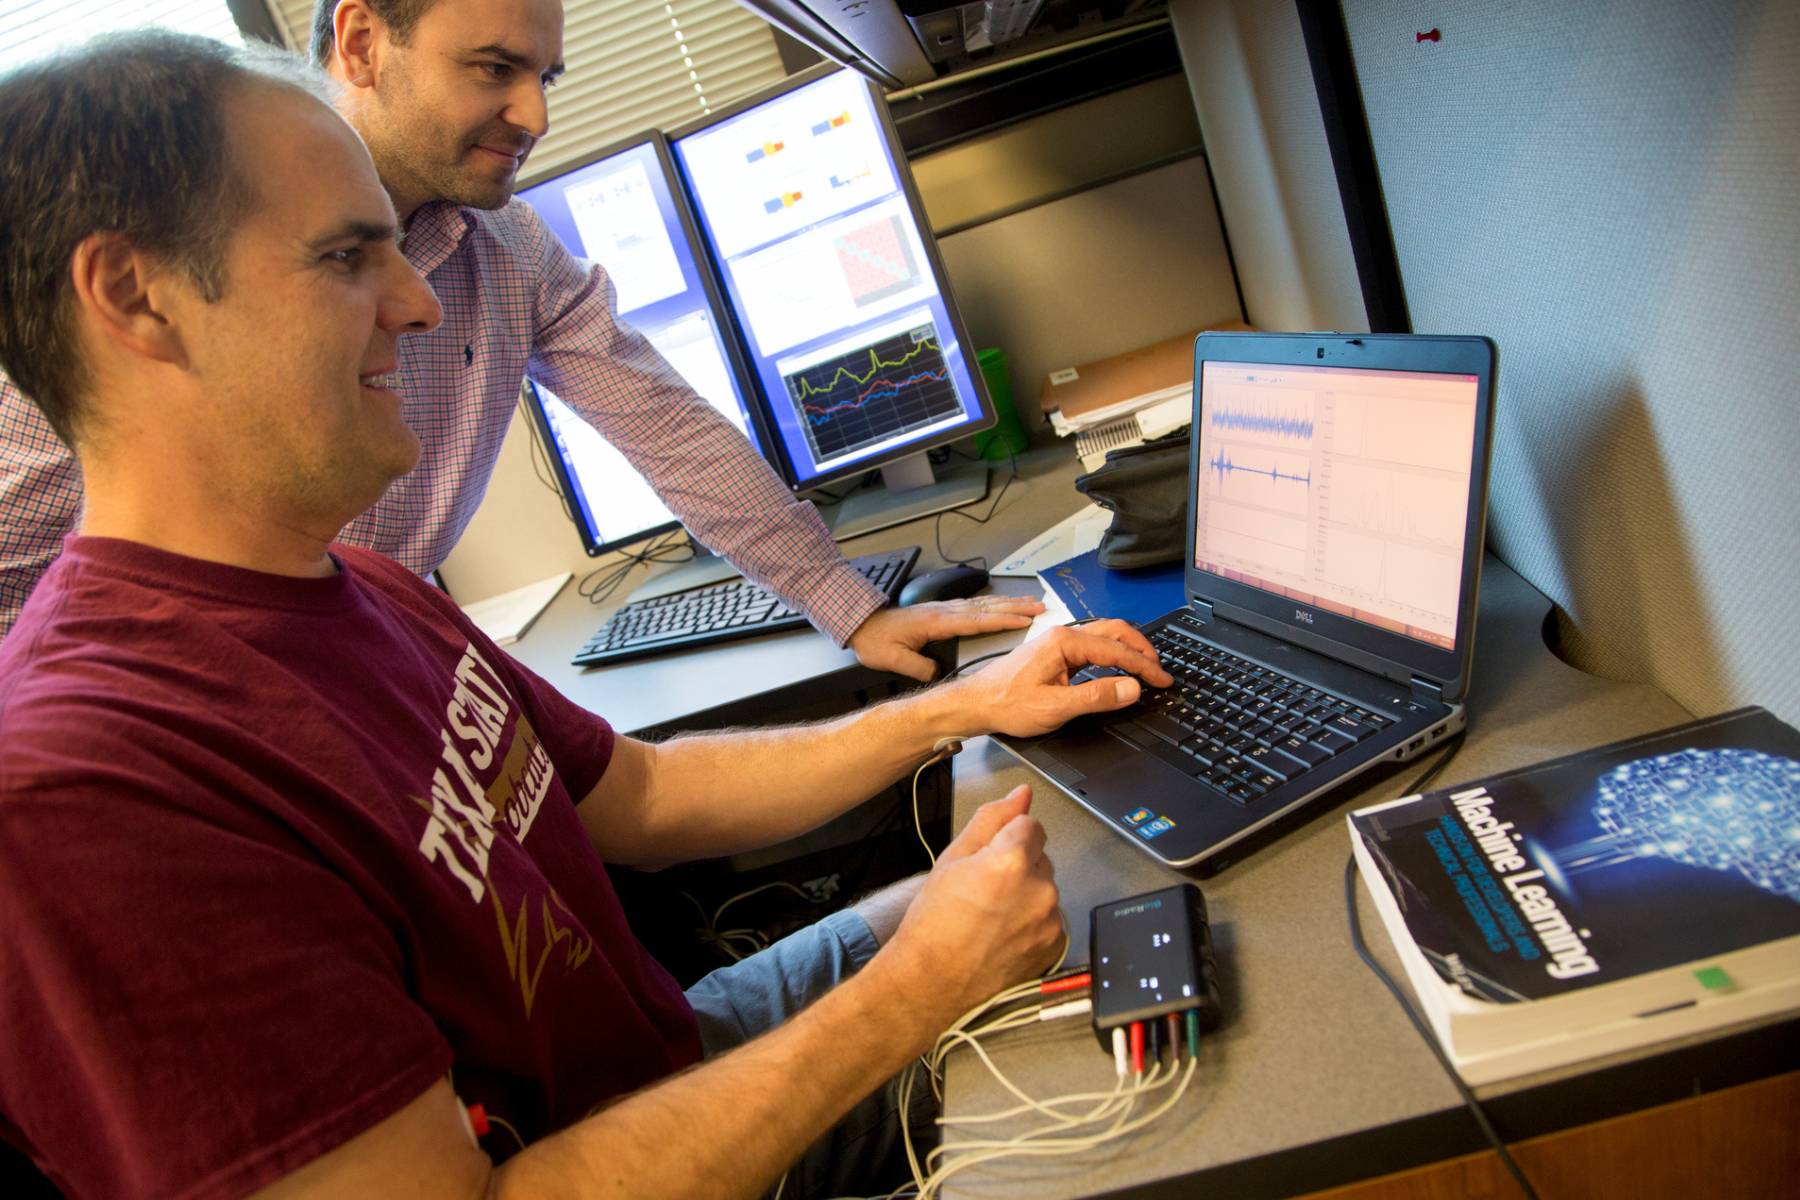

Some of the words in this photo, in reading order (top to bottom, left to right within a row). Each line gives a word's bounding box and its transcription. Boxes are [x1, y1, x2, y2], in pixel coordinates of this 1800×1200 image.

[1295, 609, 1314, 625] DELL
[418, 728, 497, 904] TEXA
[1449, 786, 1526, 873] Machine
[1503, 869, 1601, 980] Learning
